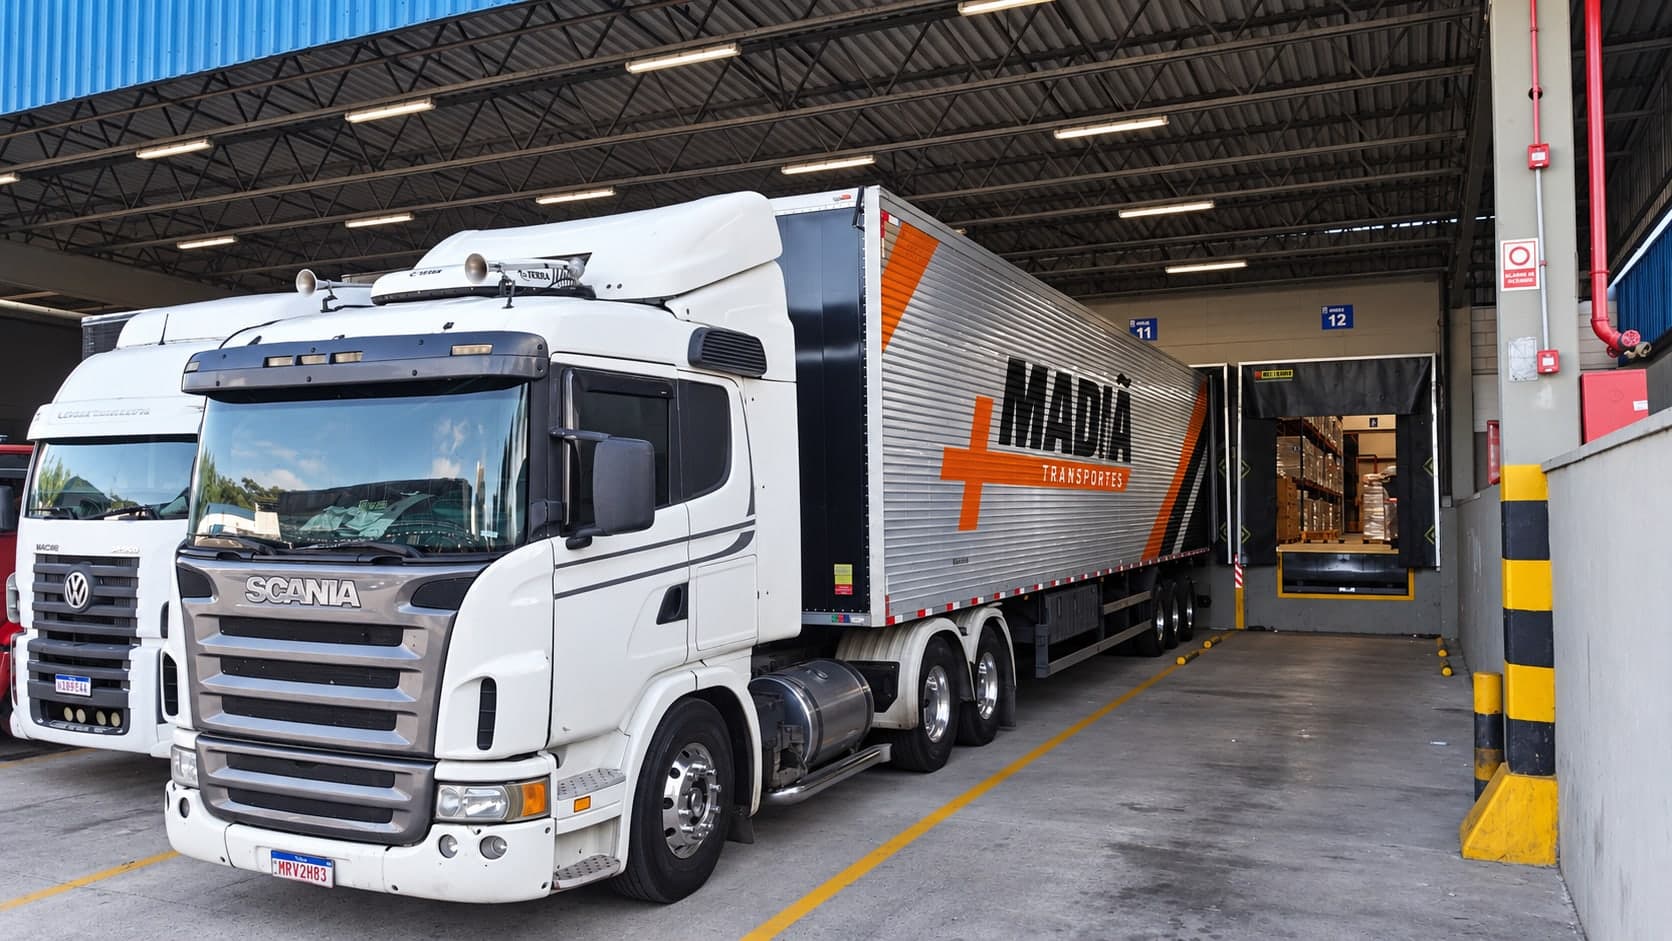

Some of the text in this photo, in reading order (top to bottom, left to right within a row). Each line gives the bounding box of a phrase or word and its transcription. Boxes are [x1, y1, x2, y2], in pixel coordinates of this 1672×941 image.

[1328, 313, 1347, 327] 12
[1136, 326, 1151, 339] 11
[1042, 464, 1123, 488] TRANSPORTES
[245, 575, 361, 608] SCANIA
